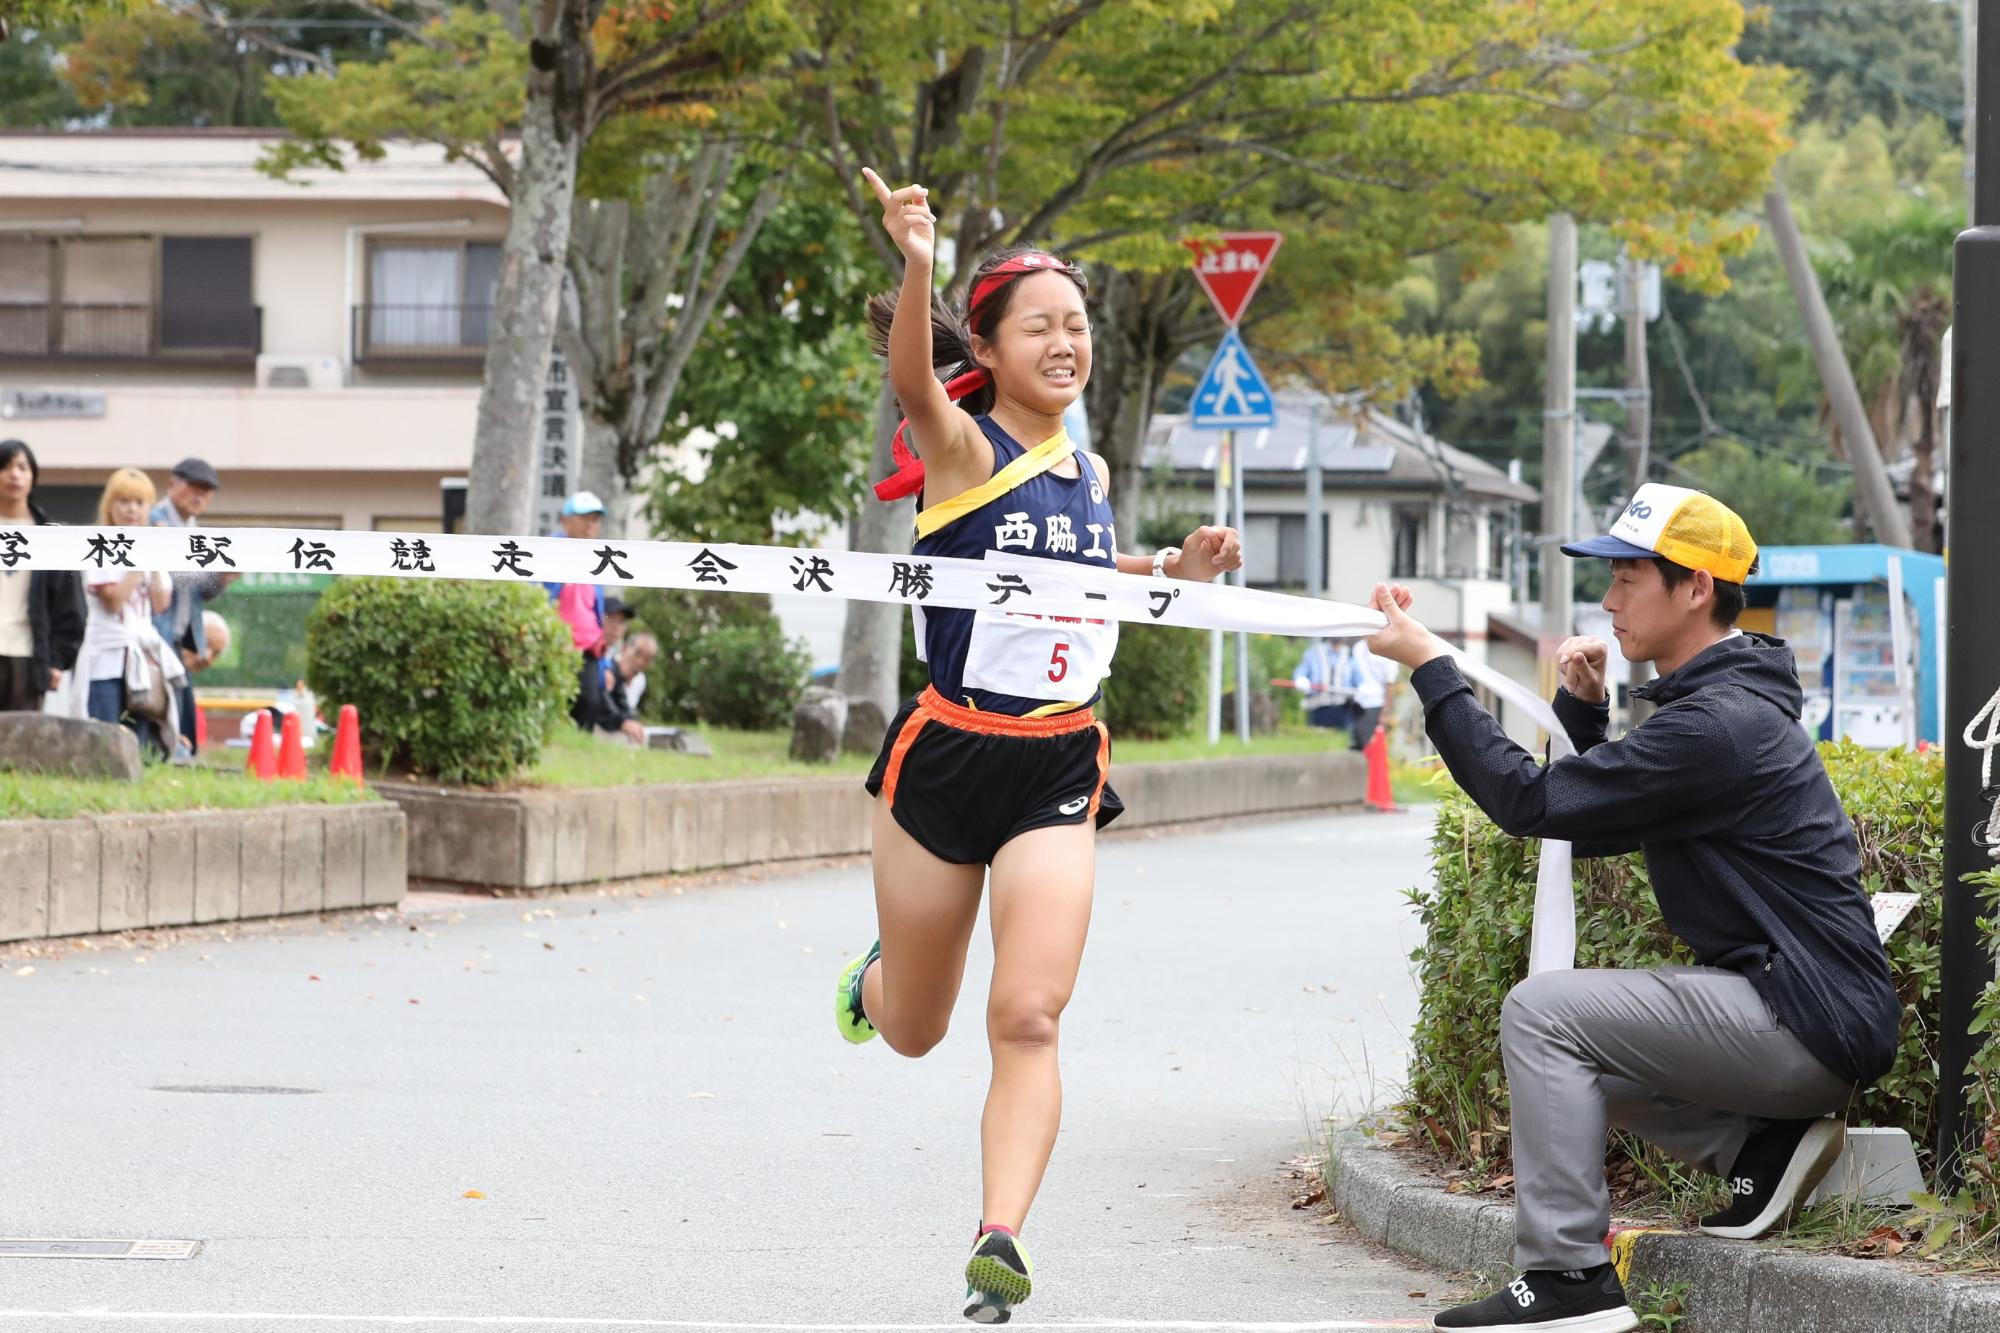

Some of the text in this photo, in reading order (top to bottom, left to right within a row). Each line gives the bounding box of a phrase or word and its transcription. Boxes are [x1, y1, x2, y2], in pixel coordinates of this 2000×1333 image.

[1202, 250, 1262, 274] 止まれ
[1048, 643, 1069, 682] 5
